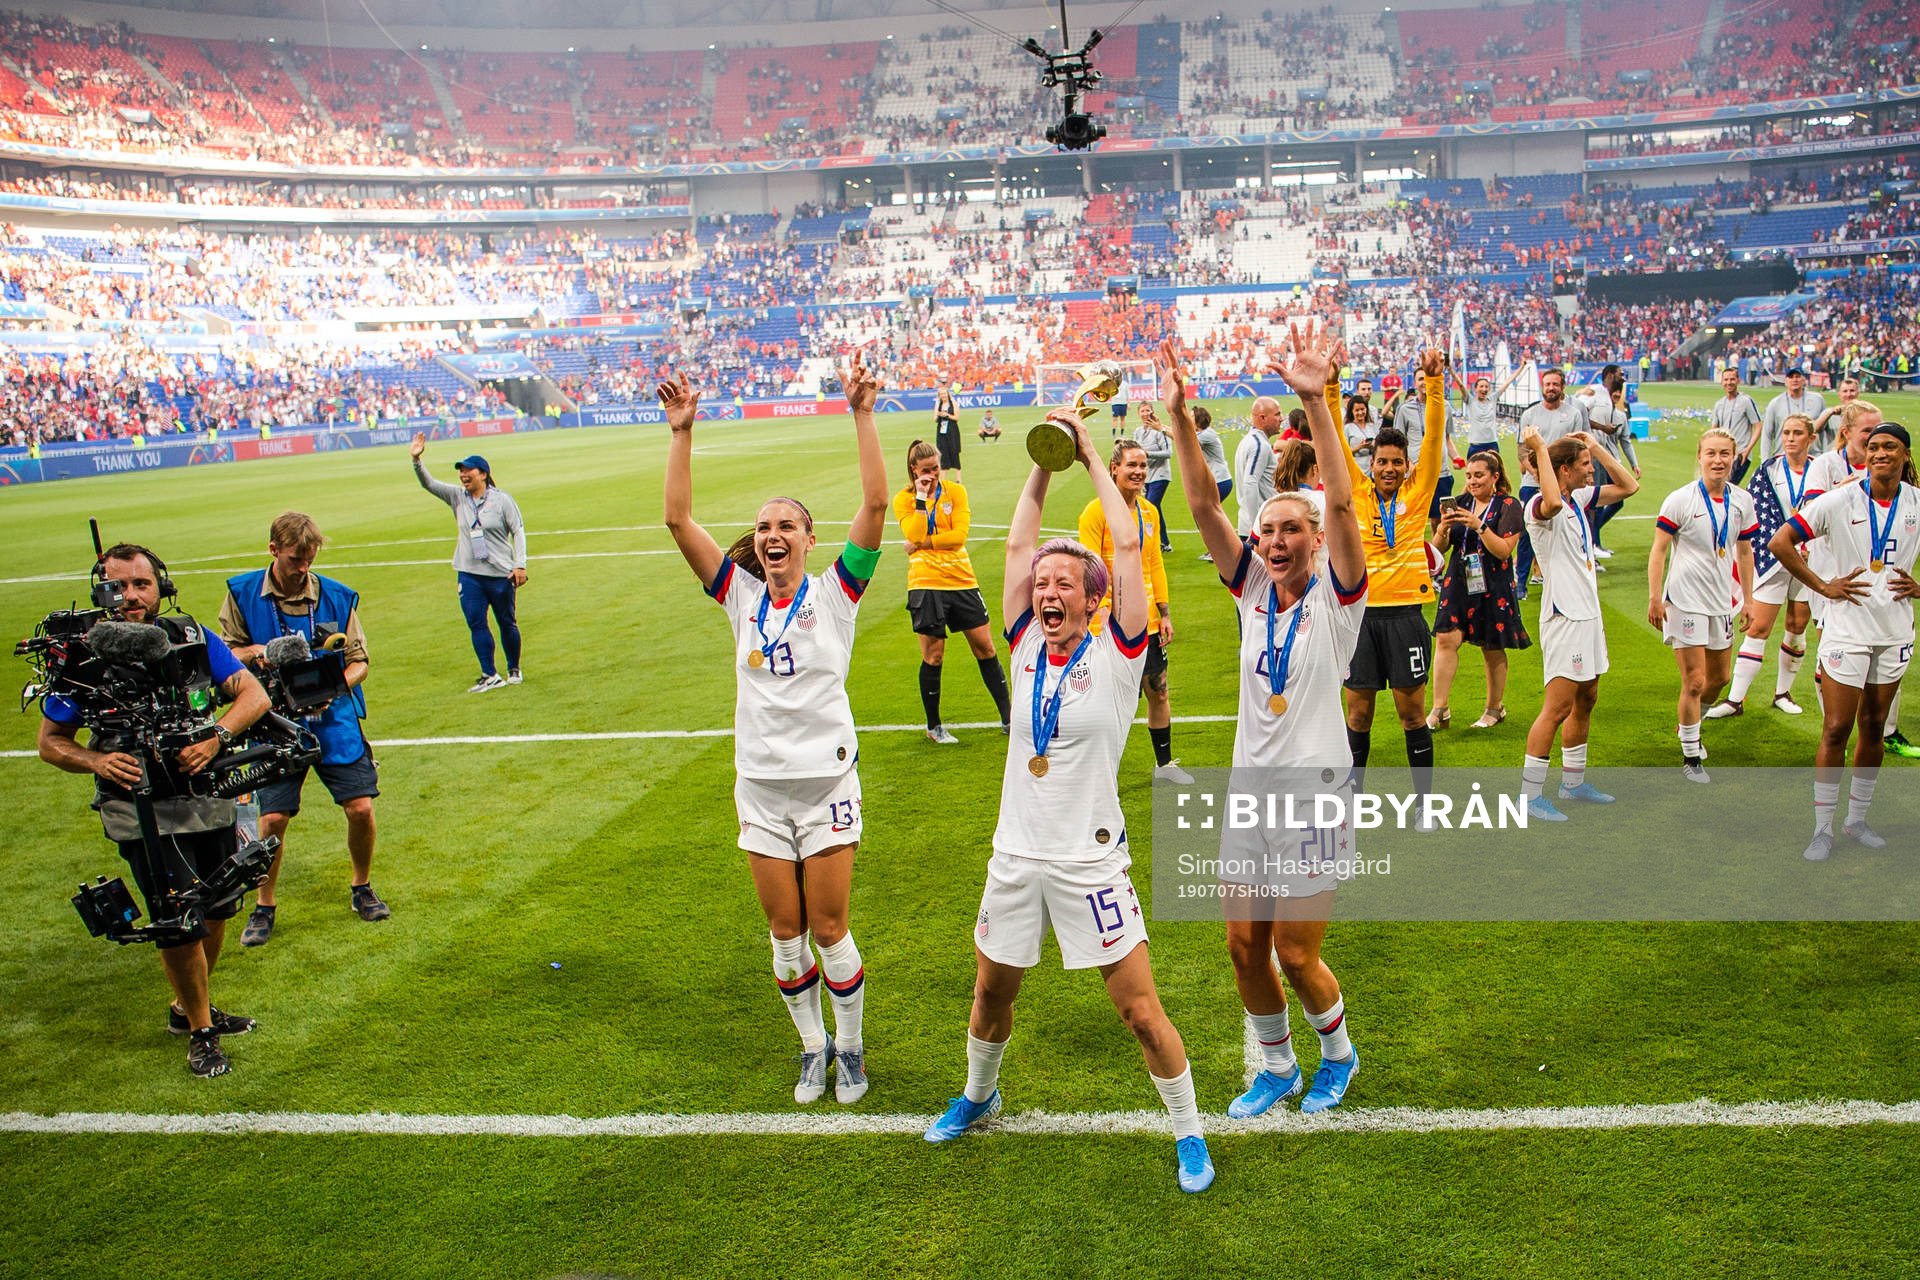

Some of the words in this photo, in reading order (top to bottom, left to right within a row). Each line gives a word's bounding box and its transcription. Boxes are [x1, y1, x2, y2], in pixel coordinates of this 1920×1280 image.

[773, 403, 817, 416] FRANCE
[976, 395, 1001, 406] YOU
[592, 412, 633, 425] THANK
[635, 411, 660, 422] YOU
[477, 421, 502, 434] FRANCE
[258, 439, 293, 457] FRANCE
[92, 453, 136, 472] THANK
[136, 450, 161, 467] YOU
[1409, 646, 1425, 672] 21
[1071, 669, 1089, 680] USA
[829, 799, 854, 826] 13
[1300, 826, 1336, 866] 20
[1086, 887, 1124, 934] 15
